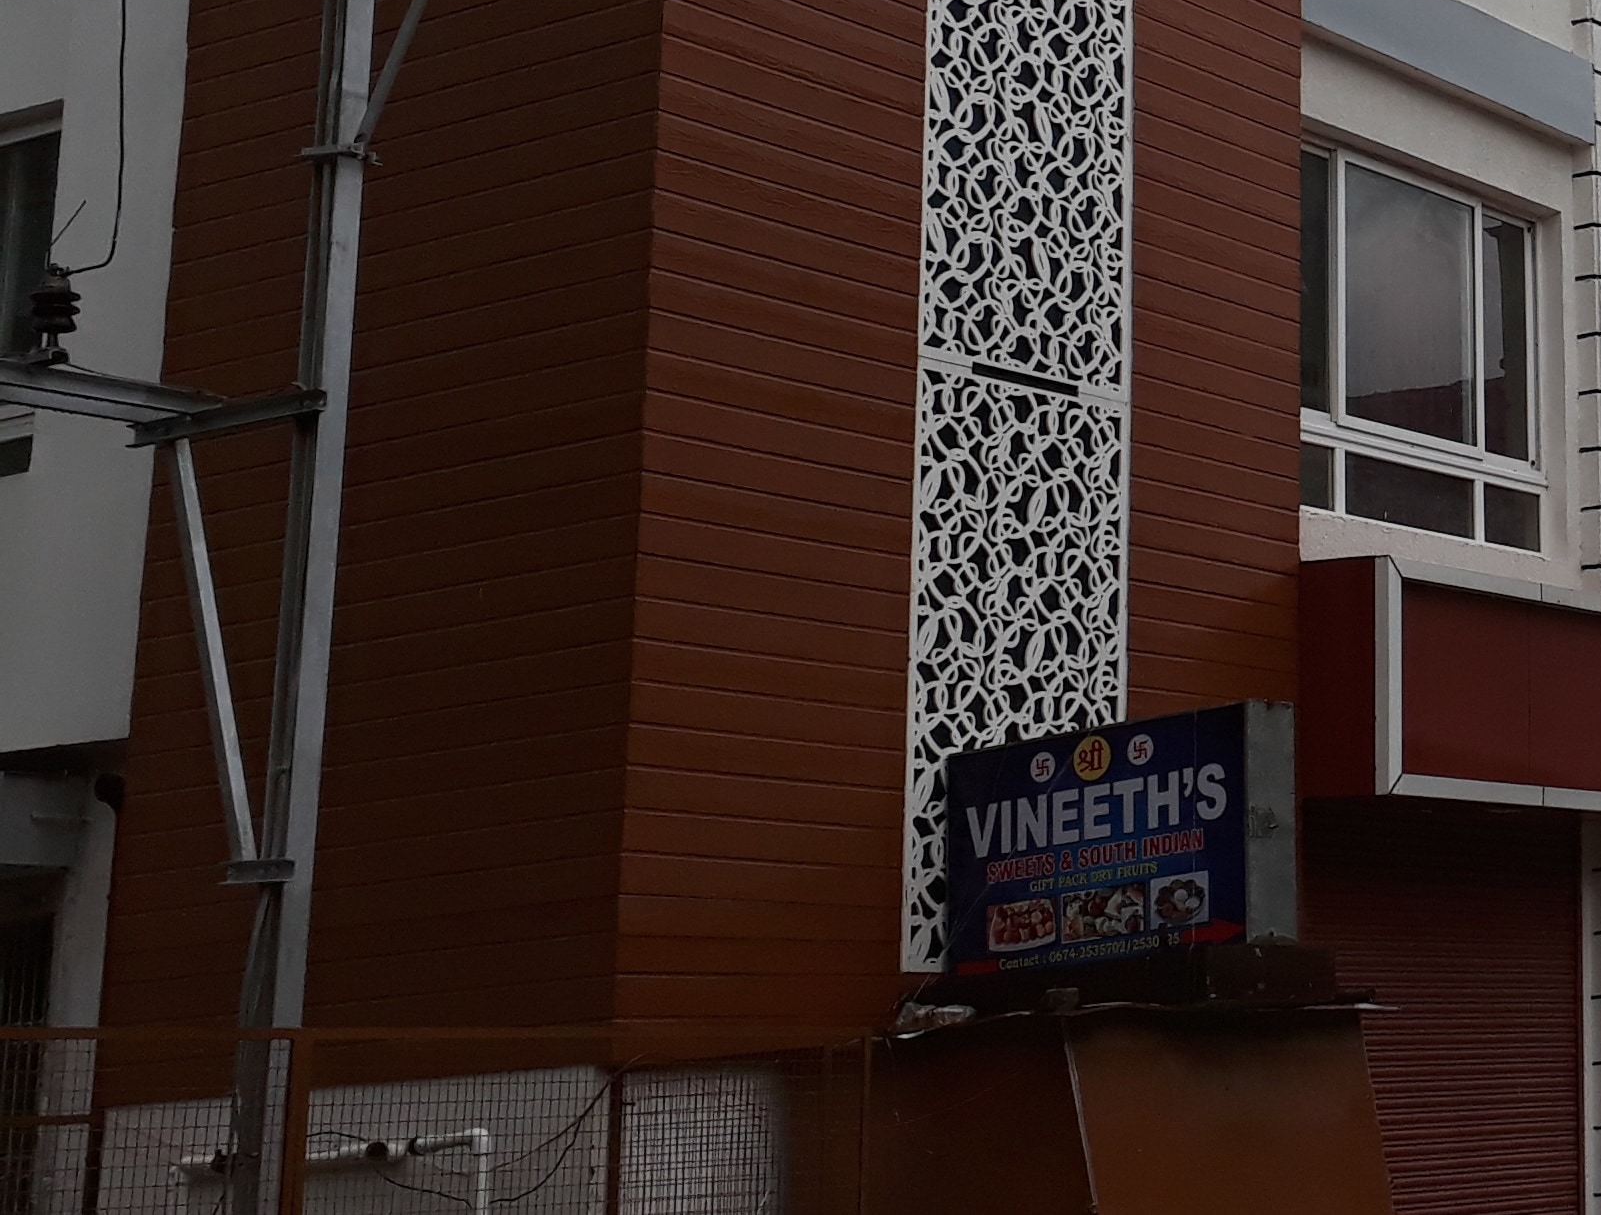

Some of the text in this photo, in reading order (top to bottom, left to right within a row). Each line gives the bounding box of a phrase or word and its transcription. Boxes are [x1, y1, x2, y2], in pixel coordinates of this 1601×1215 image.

[1075, 738, 1105, 773] श्री
[966, 762, 1228, 859] VINEETH'S
[986, 828, 1204, 885] SWEETS & SOUTH INDIAN
[1029, 876, 1055, 893] GIFT
[1058, 872, 1089, 888] PACK
[1117, 861, 1159, 879] FRUITS
